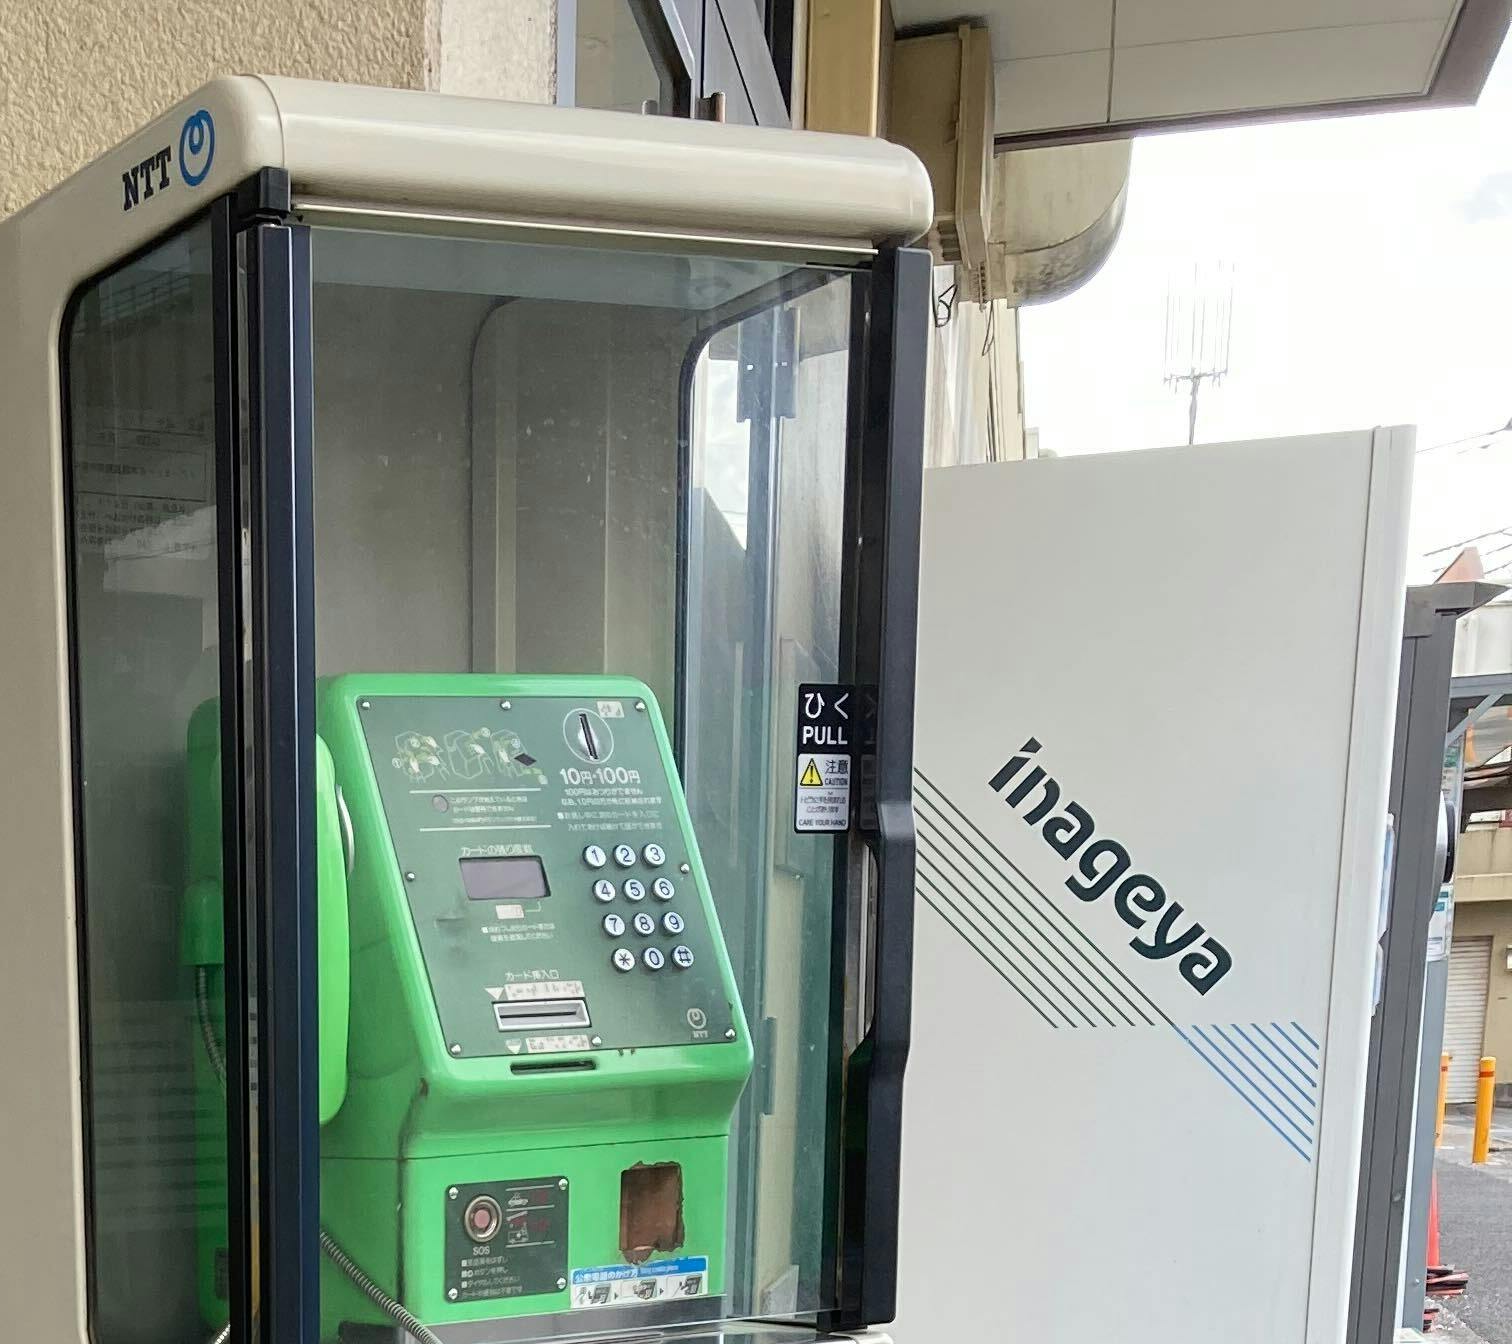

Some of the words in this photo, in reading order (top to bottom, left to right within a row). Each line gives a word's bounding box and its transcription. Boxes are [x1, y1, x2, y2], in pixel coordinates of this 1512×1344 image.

[122, 145, 172, 212] NTT
[804, 692, 849, 720] ひく
[802, 725, 849, 745] PULL
[824, 759, 849, 775] 注意
[987, 736, 1234, 997] inageya
[472, 1245, 490, 1256] SOS
